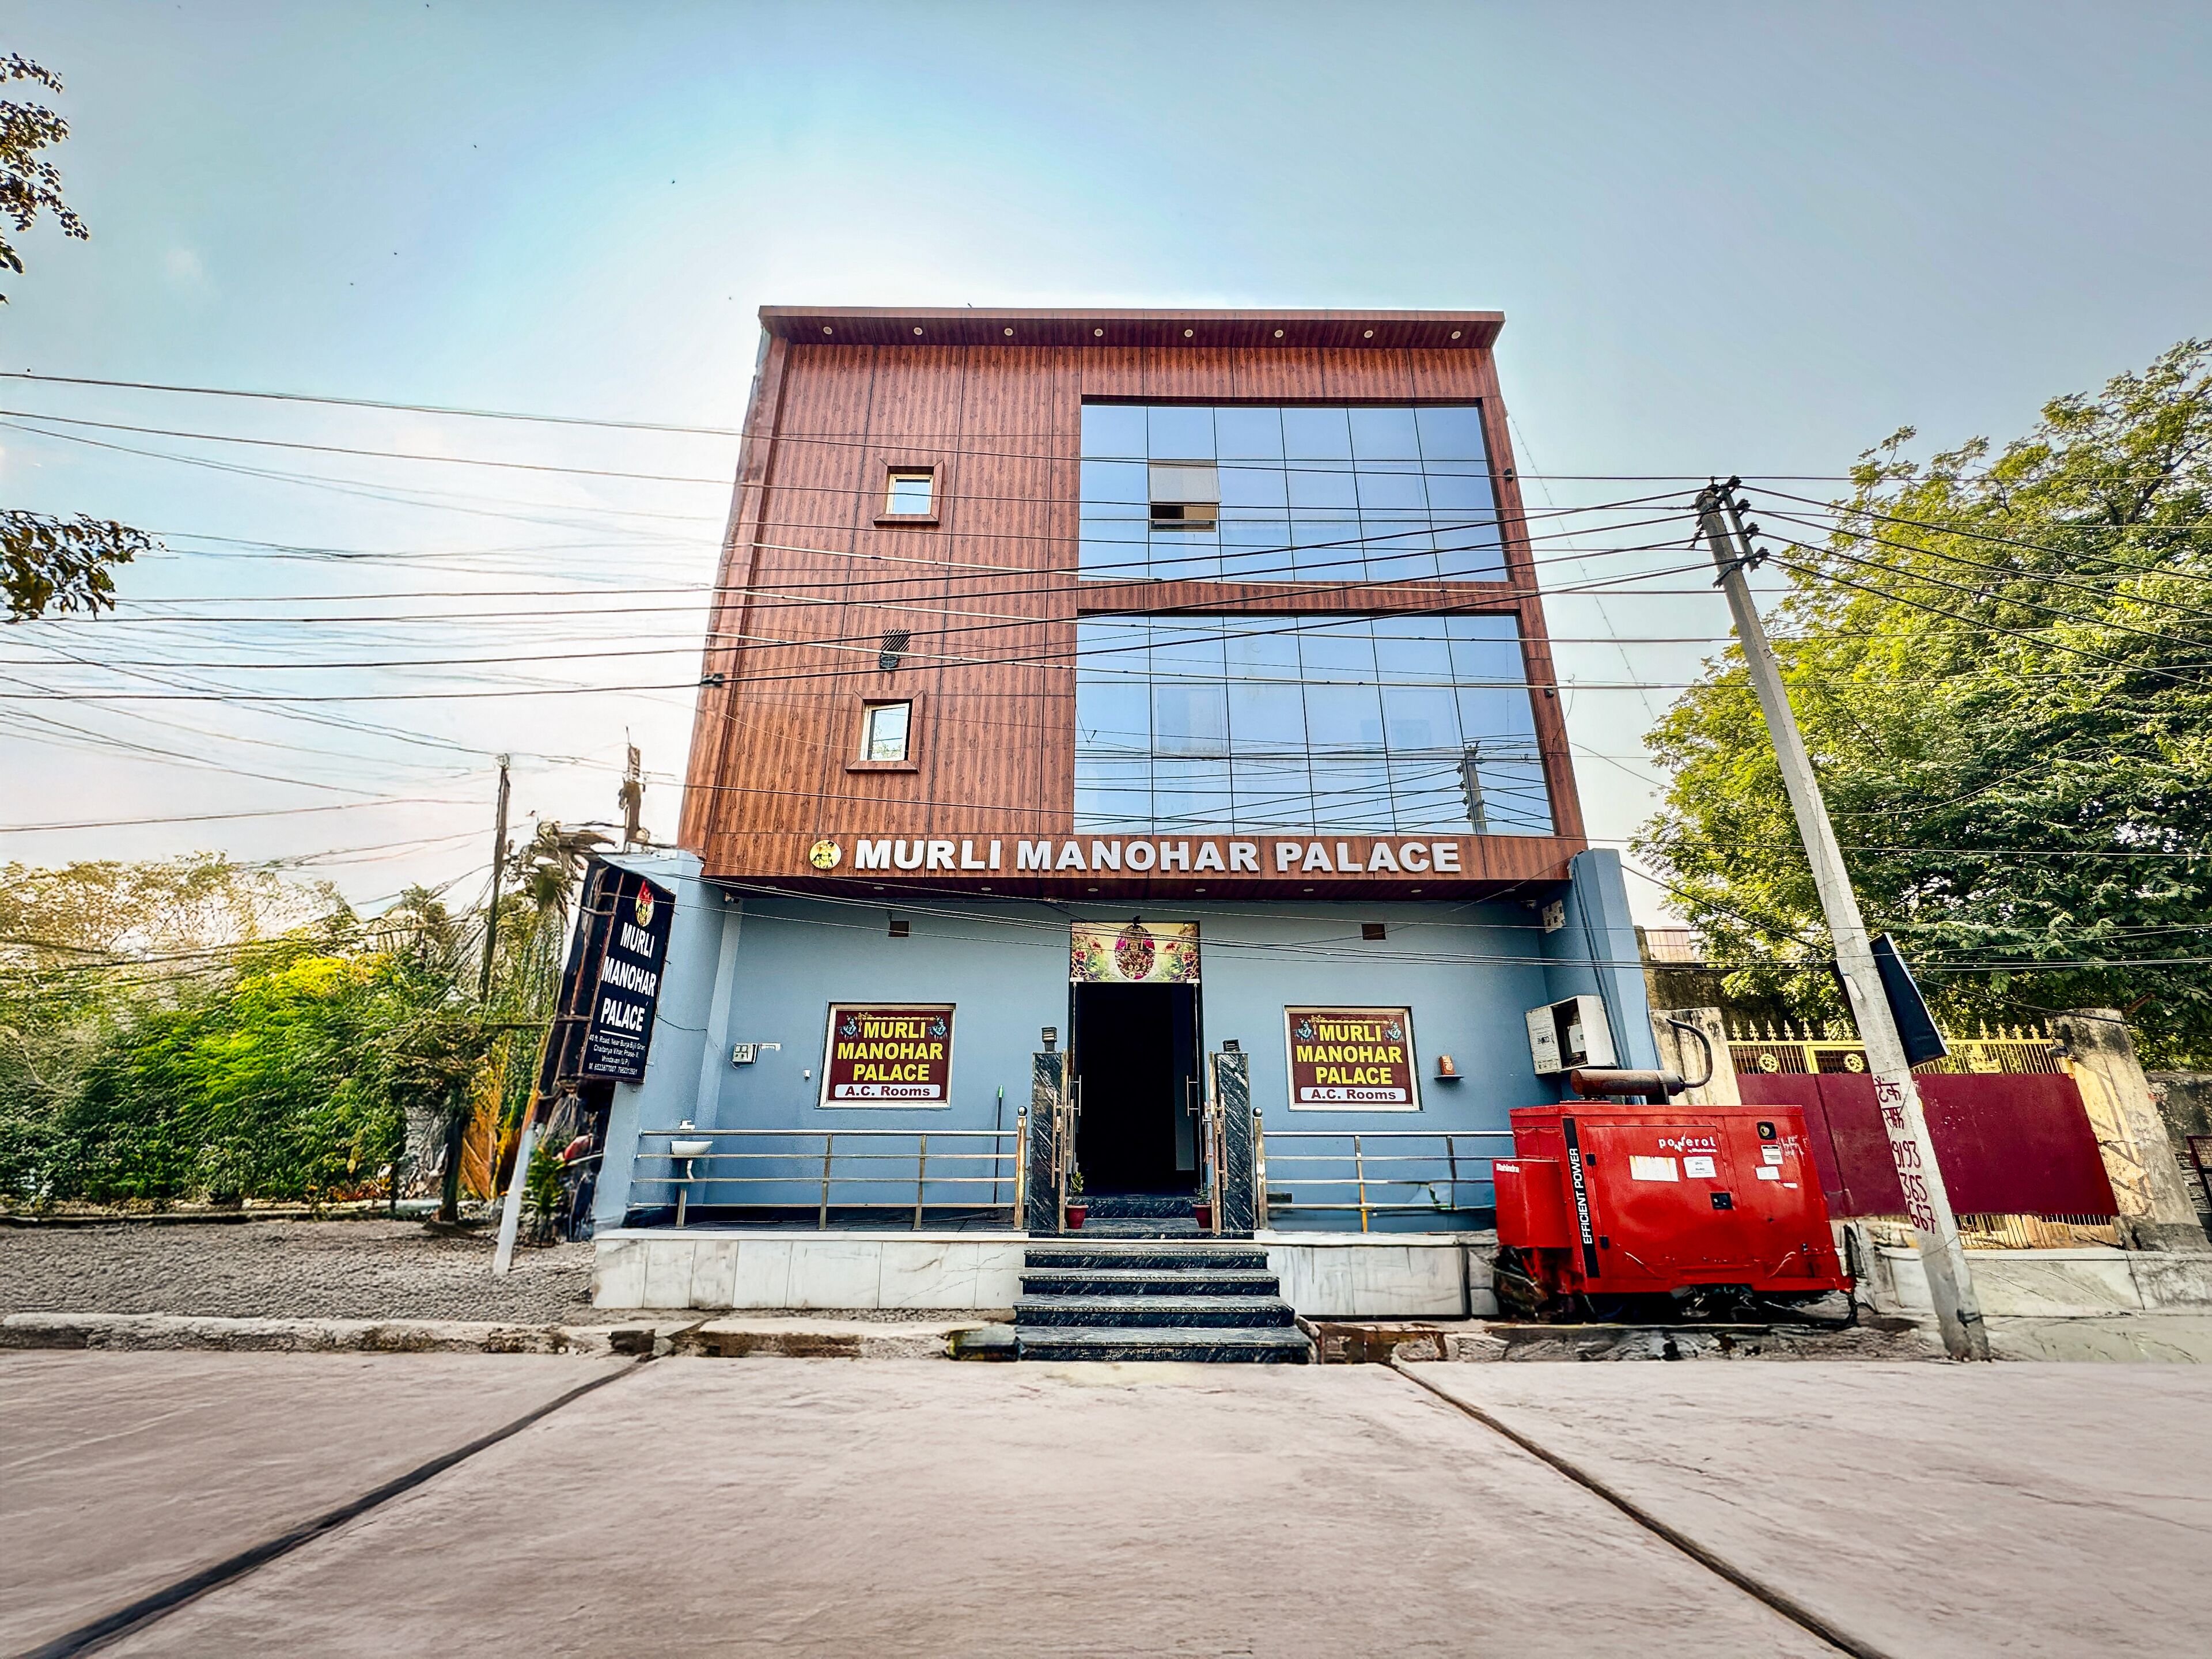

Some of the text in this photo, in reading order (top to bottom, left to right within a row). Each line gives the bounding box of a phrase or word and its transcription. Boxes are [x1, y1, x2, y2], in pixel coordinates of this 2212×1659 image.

[855, 839, 1462, 873] MURLI MANOHAR PALACE
[620, 922, 654, 958] MURLI
[601, 956, 657, 997] MANOHAR
[600, 998, 645, 1032] PALACE
[863, 1022, 926, 1038] MURLI
[1319, 1025, 1381, 1041] MURLI
[838, 1043, 943, 1060] MANOHAR
[1296, 1046, 1403, 1063] MANOHAR
[853, 1064, 930, 1081] PALACE
[1316, 1067, 1392, 1084] PALACE
[845, 1086, 930, 1096] A.C. Rooms
[1312, 1089, 1396, 1099] A.C. Rooms
[1891, 1141, 1921, 1168] 9193
[1569, 1148, 1593, 1244] EFFICIENT POWER
[1899, 1172, 1927, 1202] 365
[1907, 1200, 1936, 1234] 667
